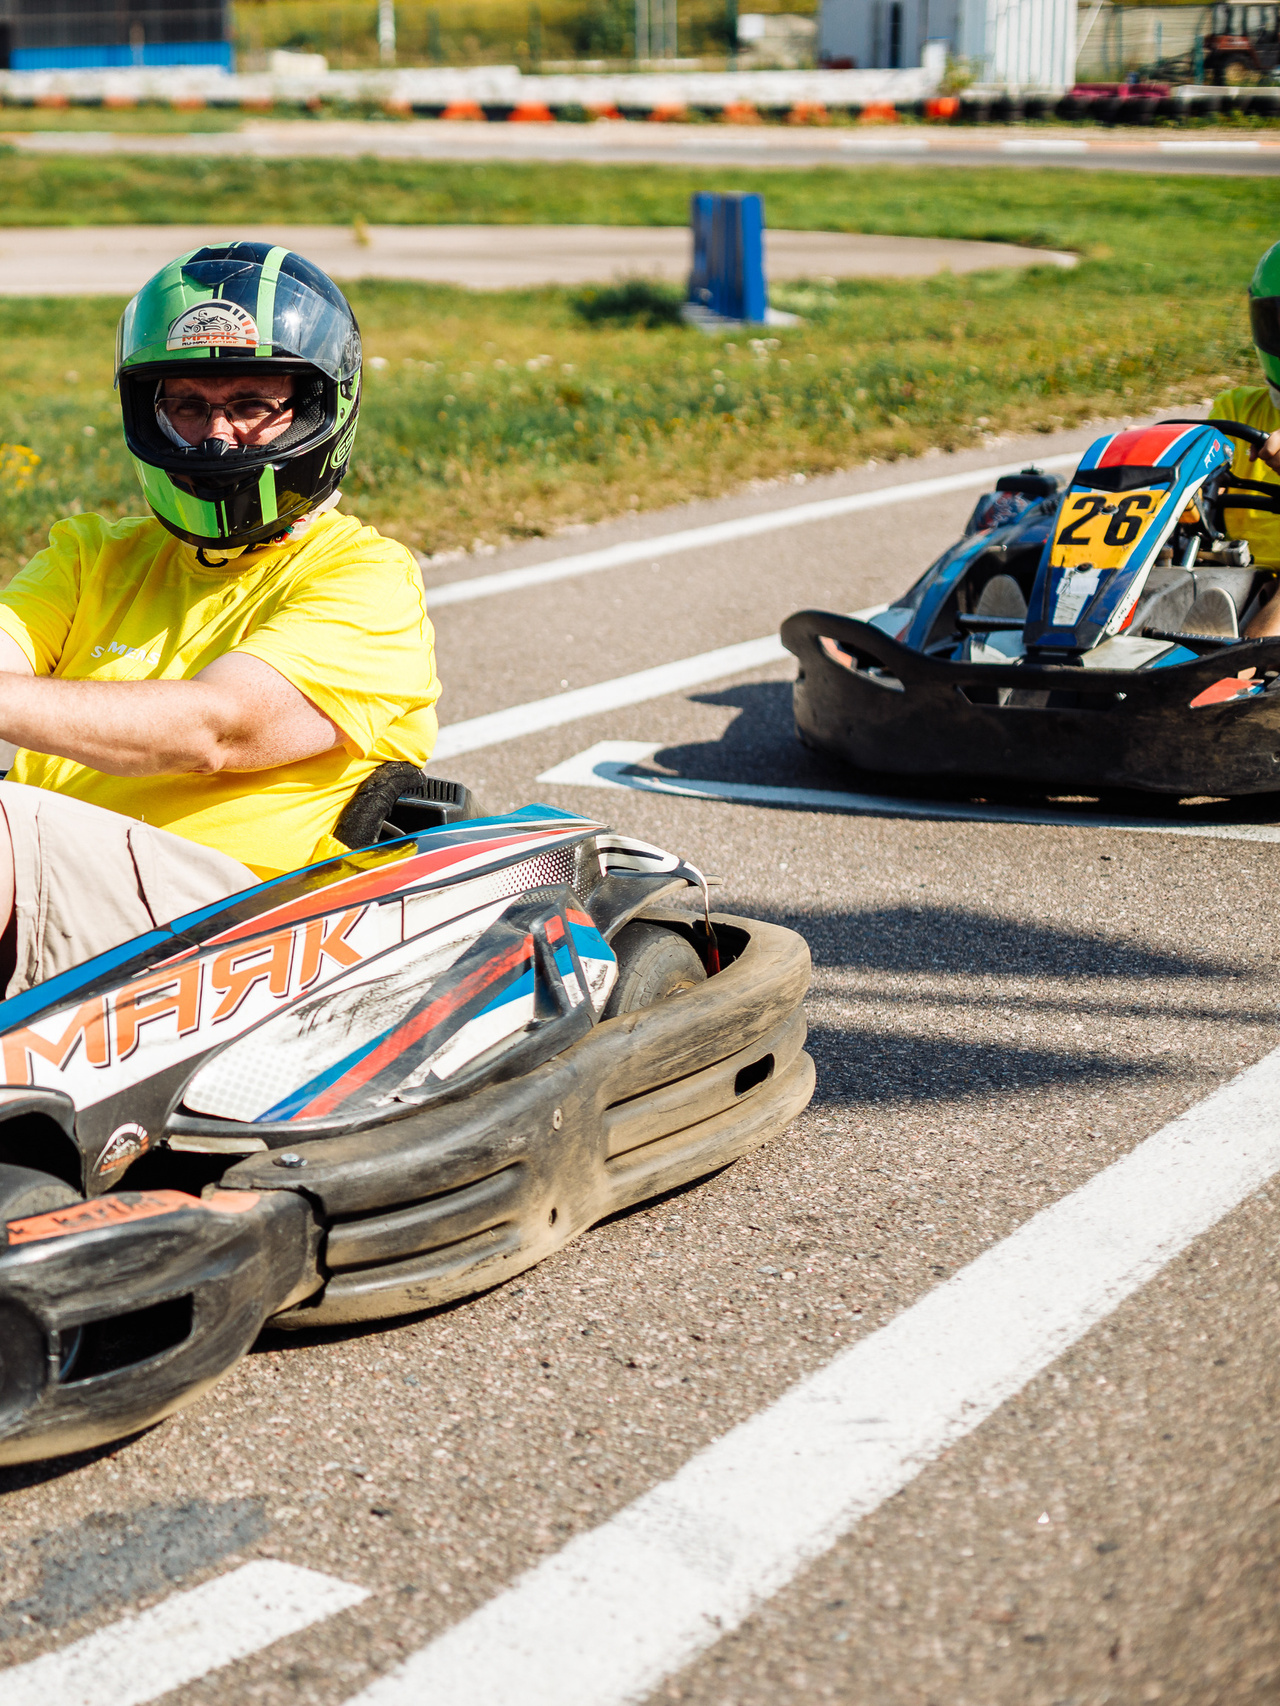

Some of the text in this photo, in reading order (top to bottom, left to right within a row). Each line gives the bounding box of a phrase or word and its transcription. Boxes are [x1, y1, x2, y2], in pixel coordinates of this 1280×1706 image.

[1057, 494, 1153, 546] 26
[90, 641, 161, 665] SMENS
[1, 903, 370, 1087] МАЯК
